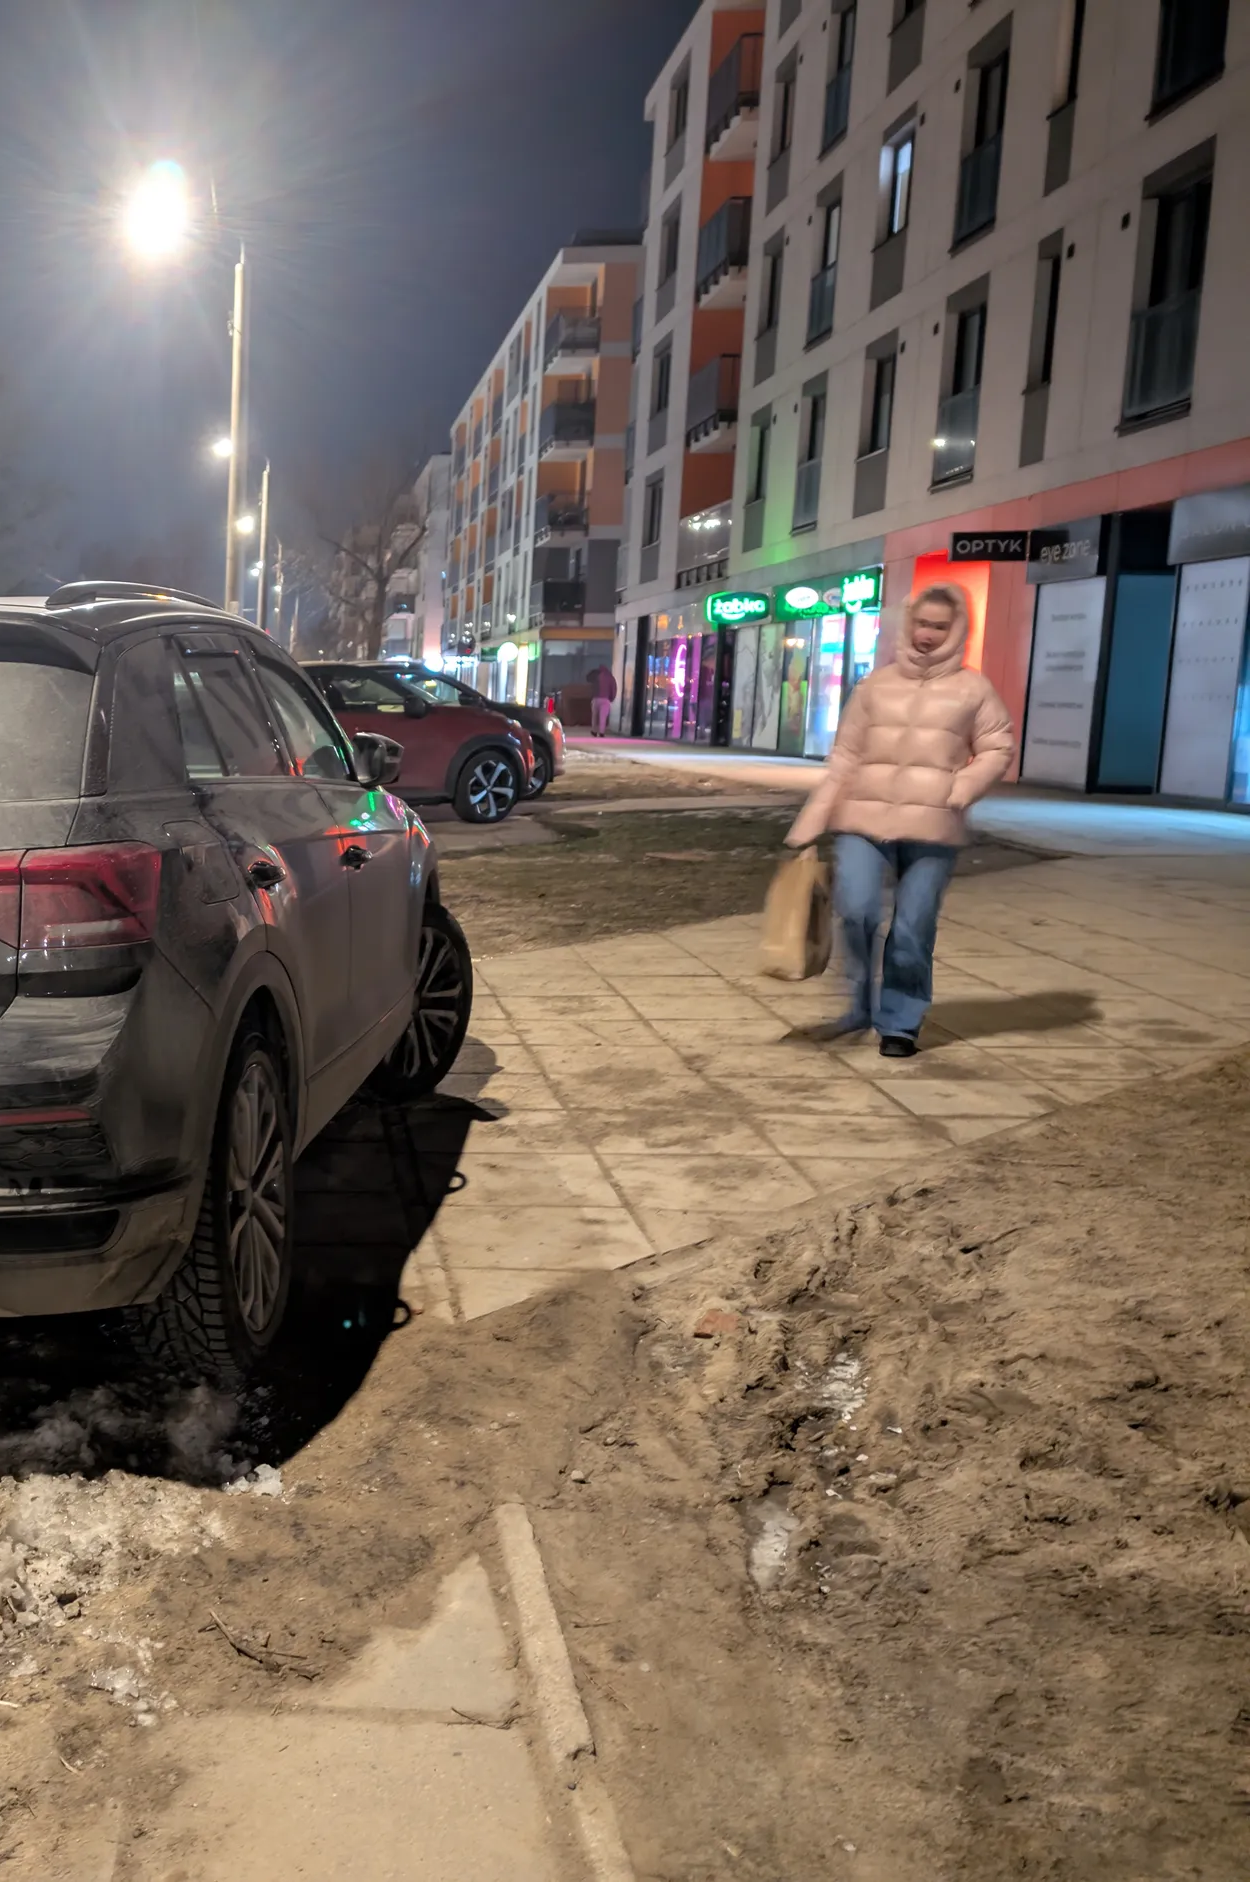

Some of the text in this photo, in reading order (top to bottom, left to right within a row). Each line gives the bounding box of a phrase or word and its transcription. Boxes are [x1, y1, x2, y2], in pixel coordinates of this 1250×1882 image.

[956, 538, 1023, 554] OPTYK
[1040, 539, 1092, 566] eye zone
